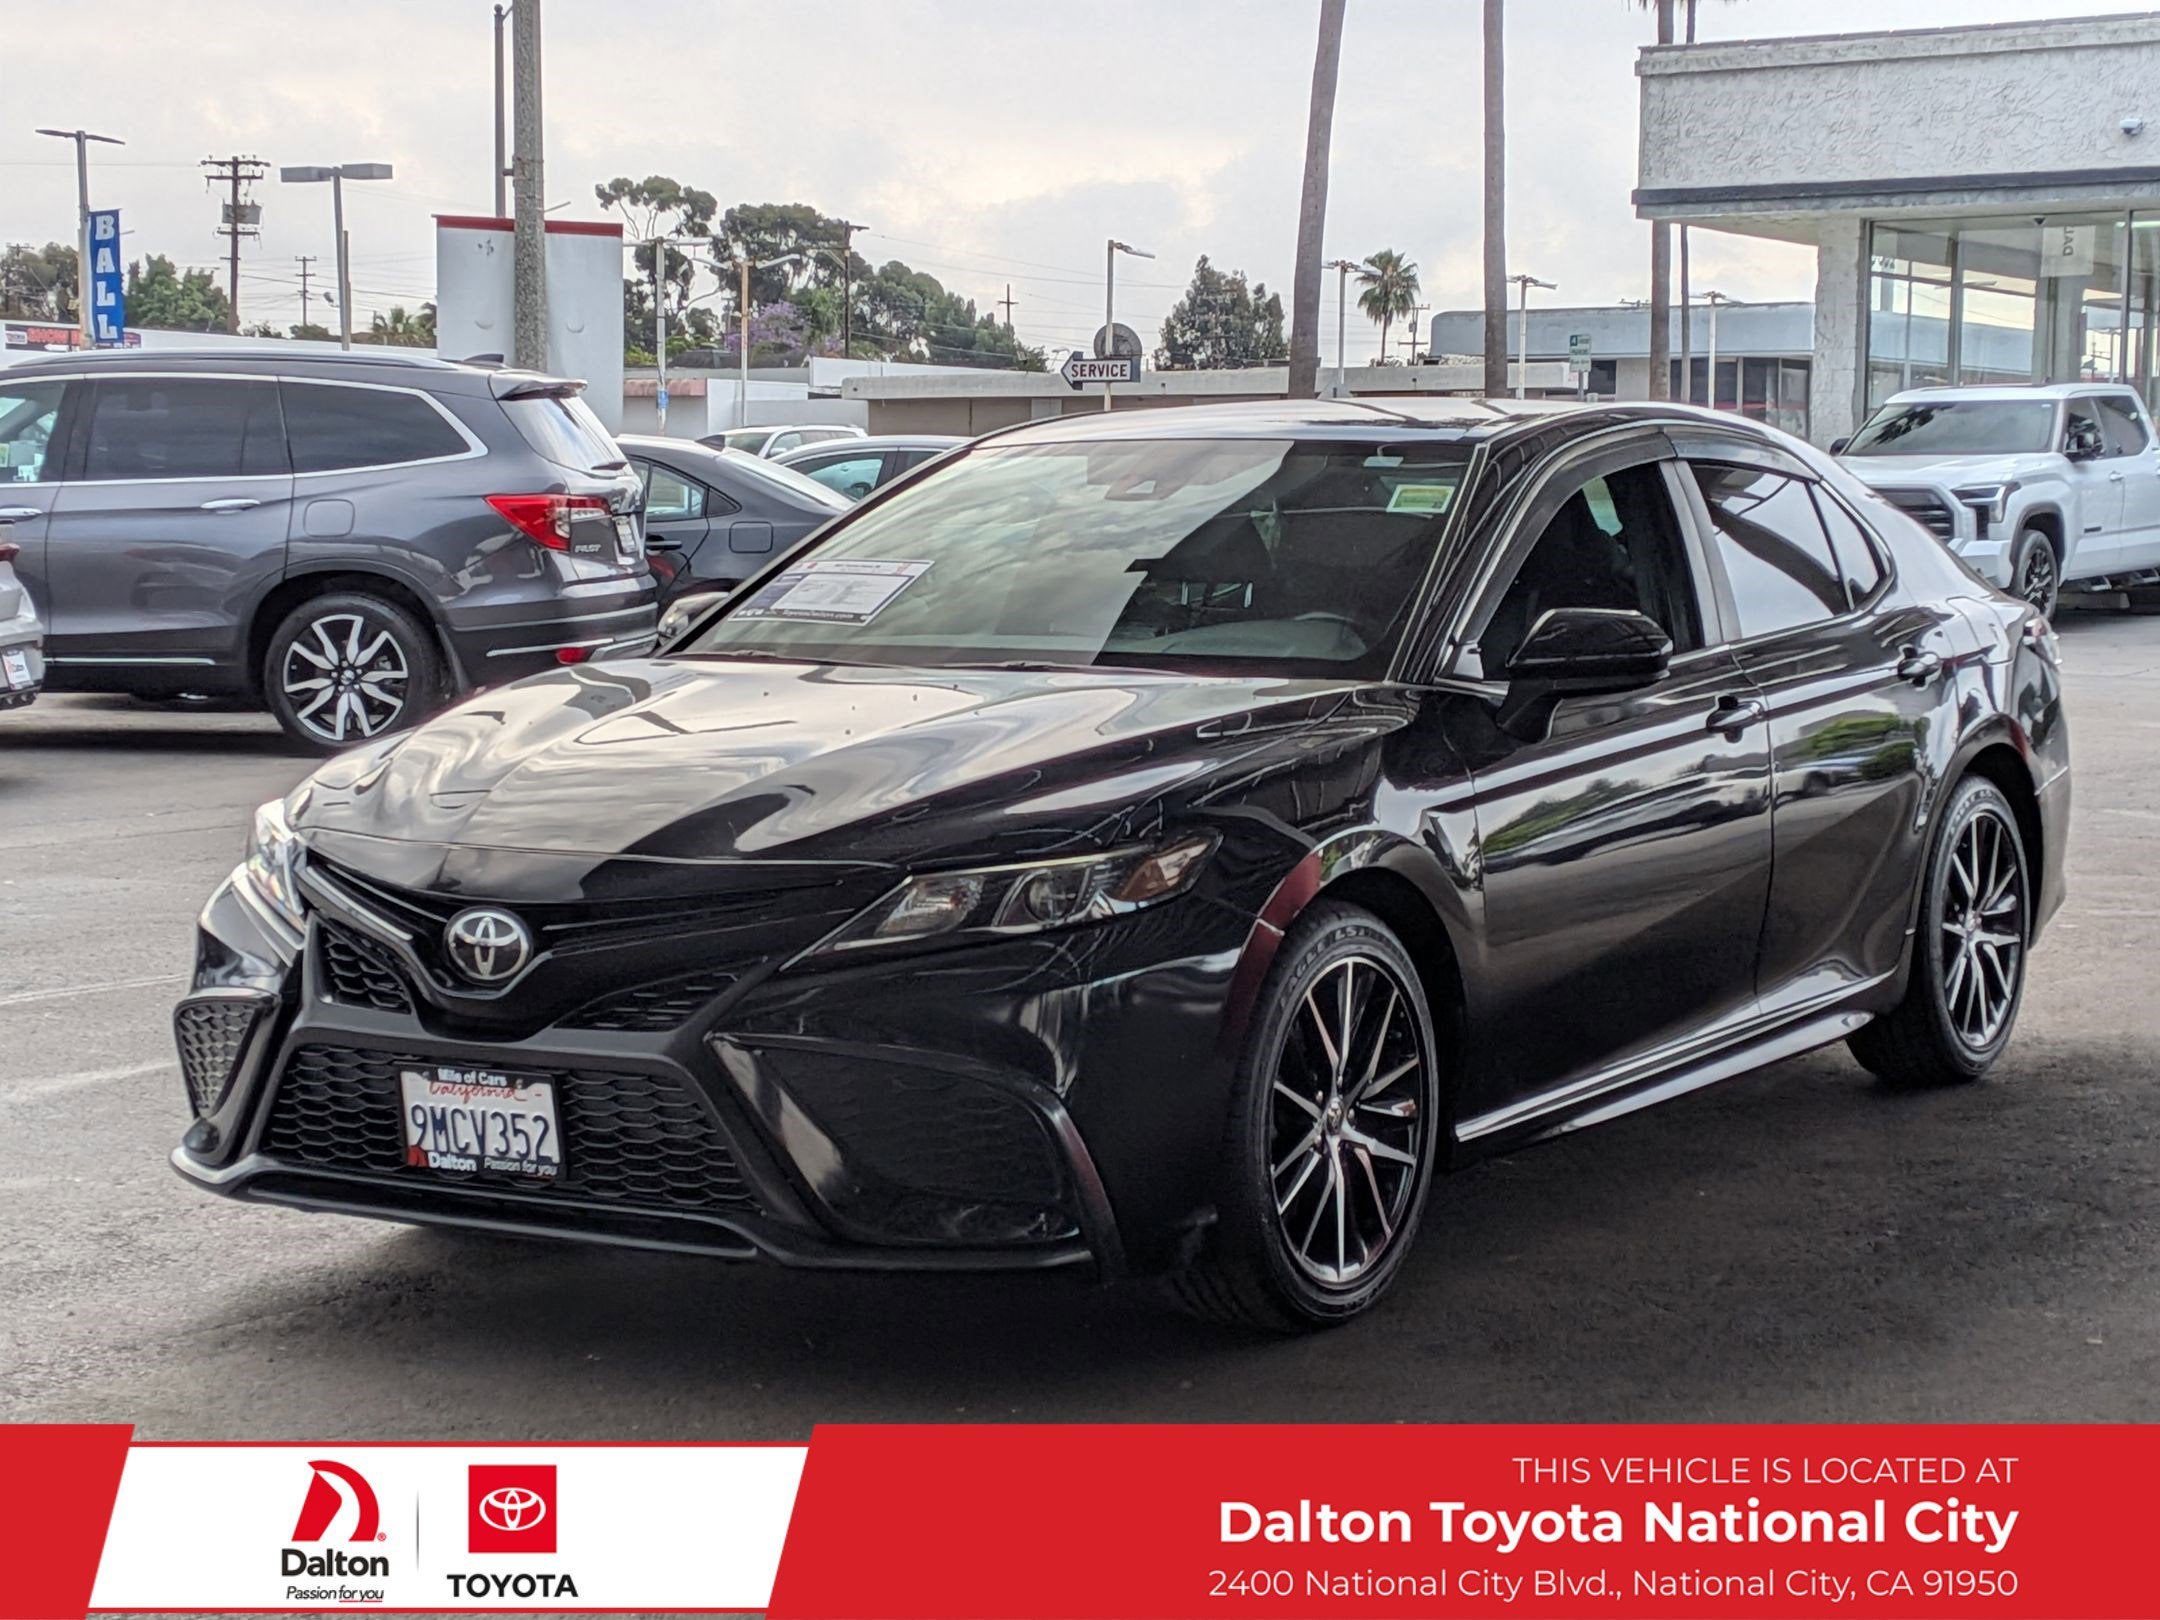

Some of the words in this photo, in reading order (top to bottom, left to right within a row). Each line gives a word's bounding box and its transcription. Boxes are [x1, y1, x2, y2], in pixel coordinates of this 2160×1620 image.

[95, 214, 119, 340] BALL
[1071, 363, 1128, 378] SERVICE
[437, 1068, 463, 1084] Mile
[463, 1071, 477, 1084] of
[478, 1071, 507, 1087] Cars
[410, 1103, 554, 1164] 9MCV352
[428, 1150, 478, 1172] Dalton
[484, 1156, 521, 1172] Passion
[521, 1158, 537, 1173] for
[537, 1162, 559, 1176] you
